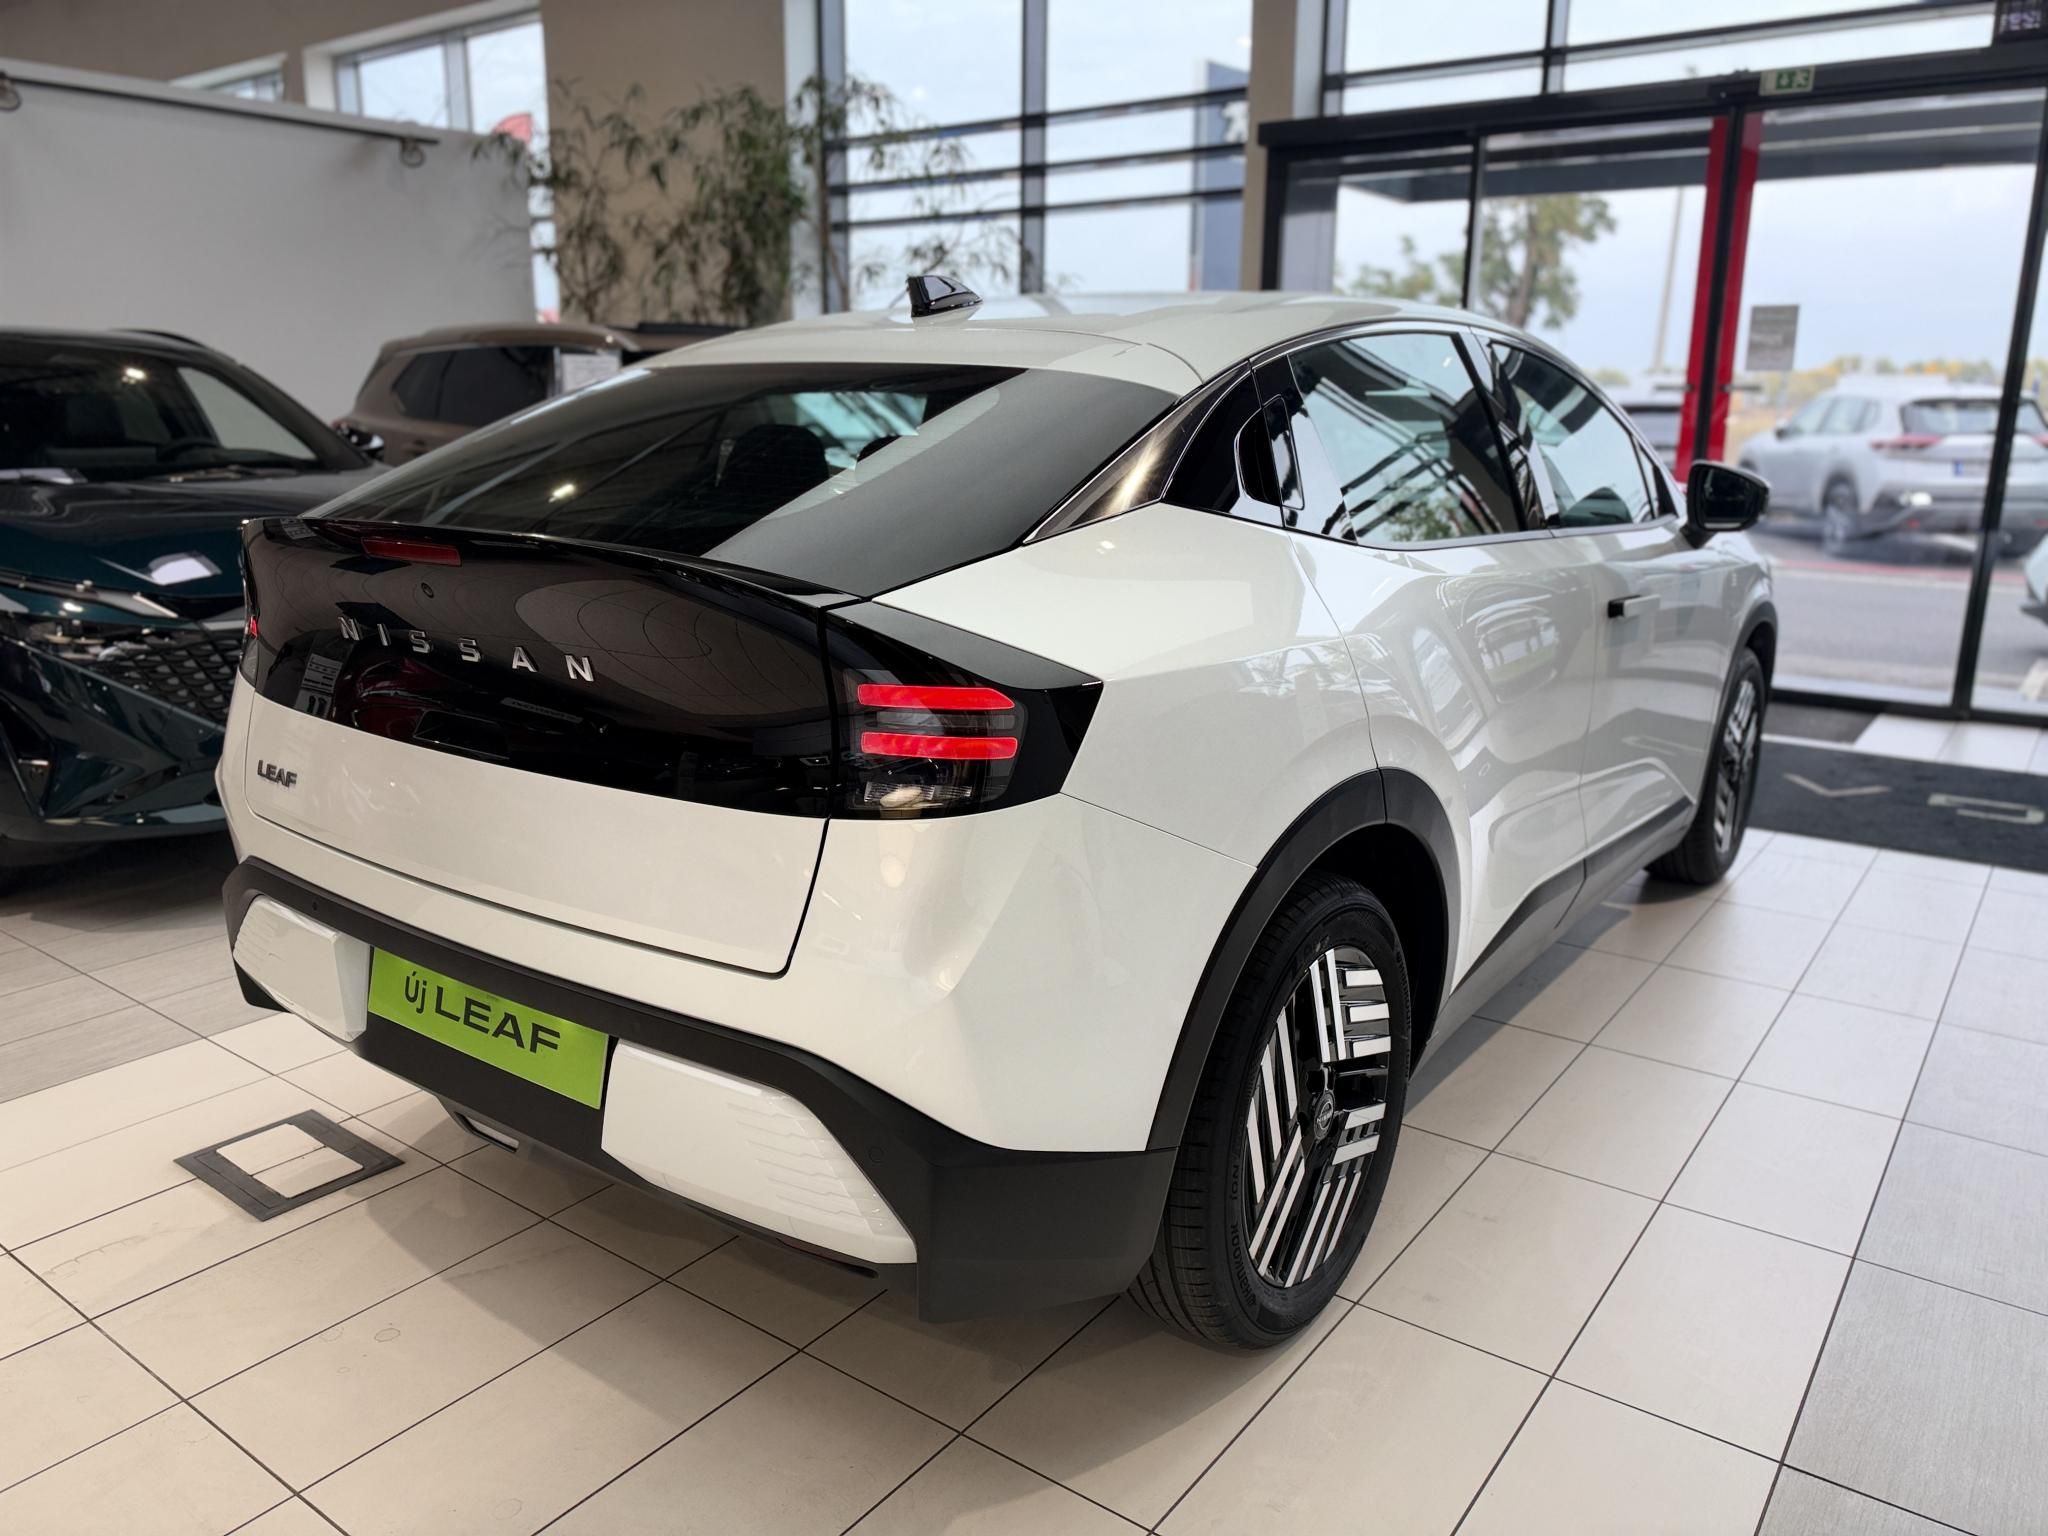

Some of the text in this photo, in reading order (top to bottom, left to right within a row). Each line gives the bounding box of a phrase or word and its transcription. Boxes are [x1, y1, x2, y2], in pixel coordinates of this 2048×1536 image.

[337, 616, 595, 682] NISSAN
[257, 759, 298, 788] LEAF
[434, 985, 561, 1053] LEAF
